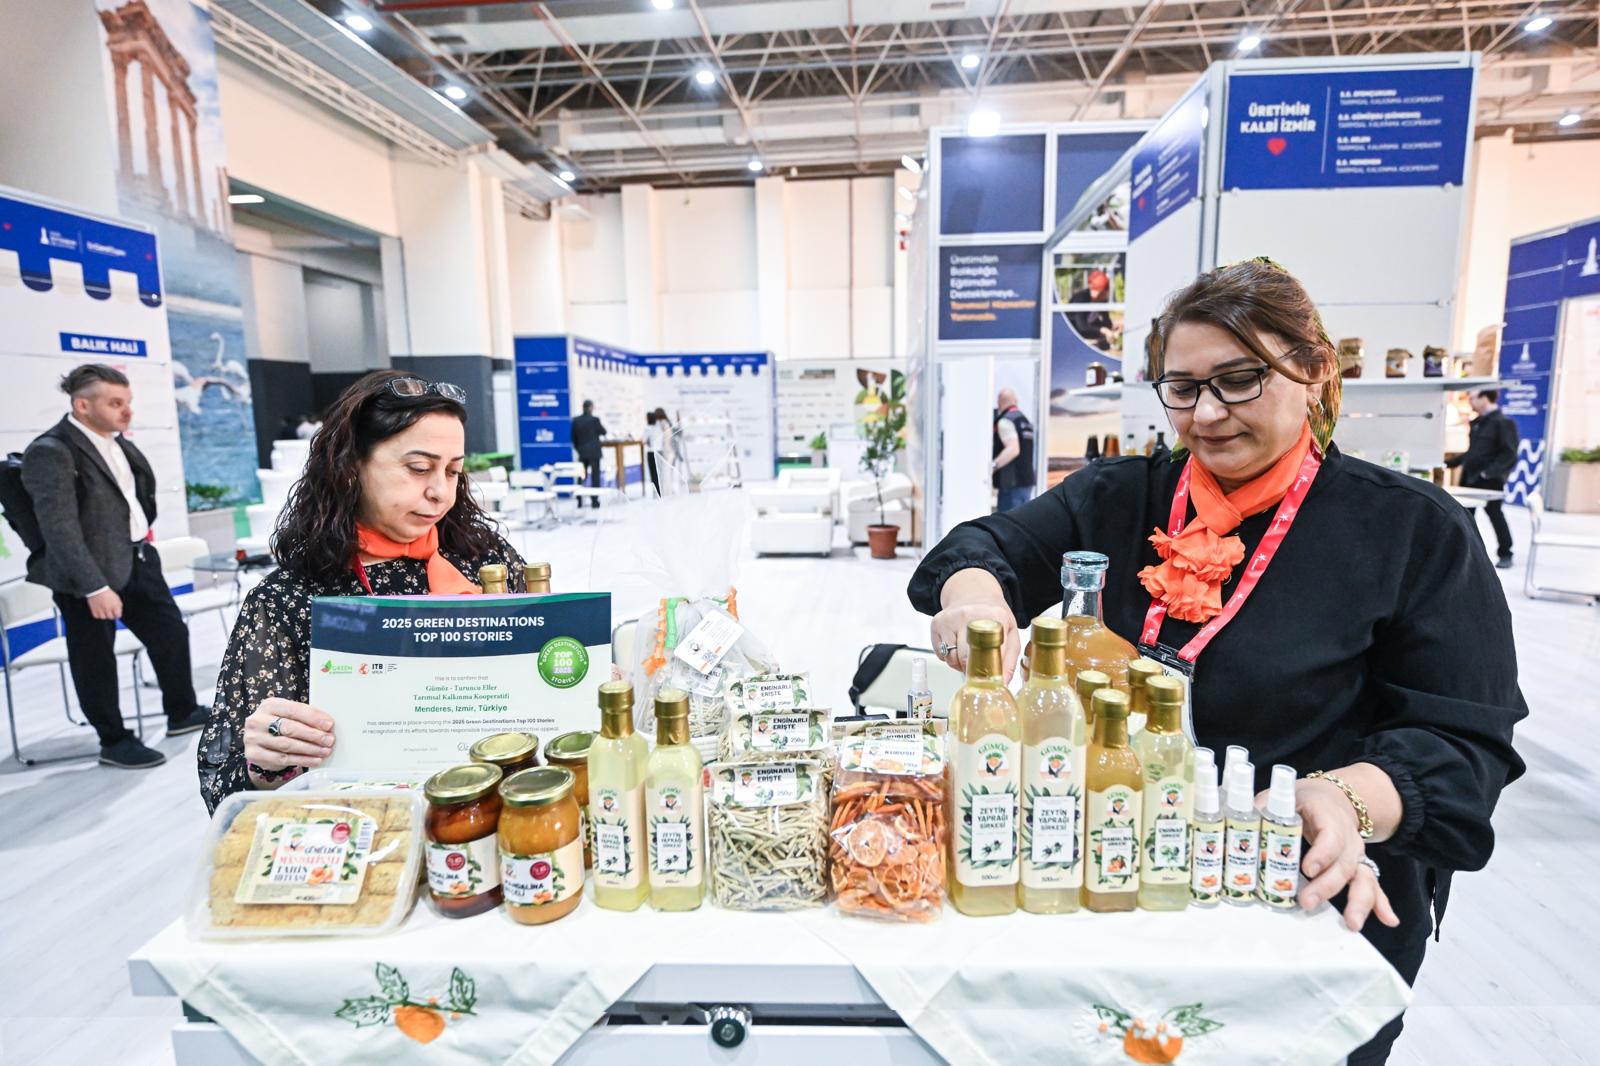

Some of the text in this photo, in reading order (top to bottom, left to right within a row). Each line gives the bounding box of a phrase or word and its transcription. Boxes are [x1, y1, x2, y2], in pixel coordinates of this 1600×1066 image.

[1248, 101, 1310, 116] ÜRETİMİN
[1240, 117, 1316, 134] KALBİ İZMİR
[71, 336, 108, 351] BALIK
[382, 616, 544, 629] 2025 GREEN DESTINATIONS
[414, 630, 513, 642] TOP 100 STORIES
[554, 658, 573, 666] 100
[478, 704, 508, 714] Türkiye
[978, 742, 1008, 754] GÜMÖZ
[1040, 745, 1072, 756] GÜMÖZ
[757, 775, 782, 783] ERİŞTE
[980, 806, 1006, 814] ZEYTİN
[1041, 808, 1068, 816] ZEYTİN
[978, 813, 1008, 822] YAPRAĞI
[1039, 816, 1070, 824] YAPRAĞI
[980, 821, 1006, 829] SİRKESİ
[1041, 823, 1067, 831] SİRKESİ
